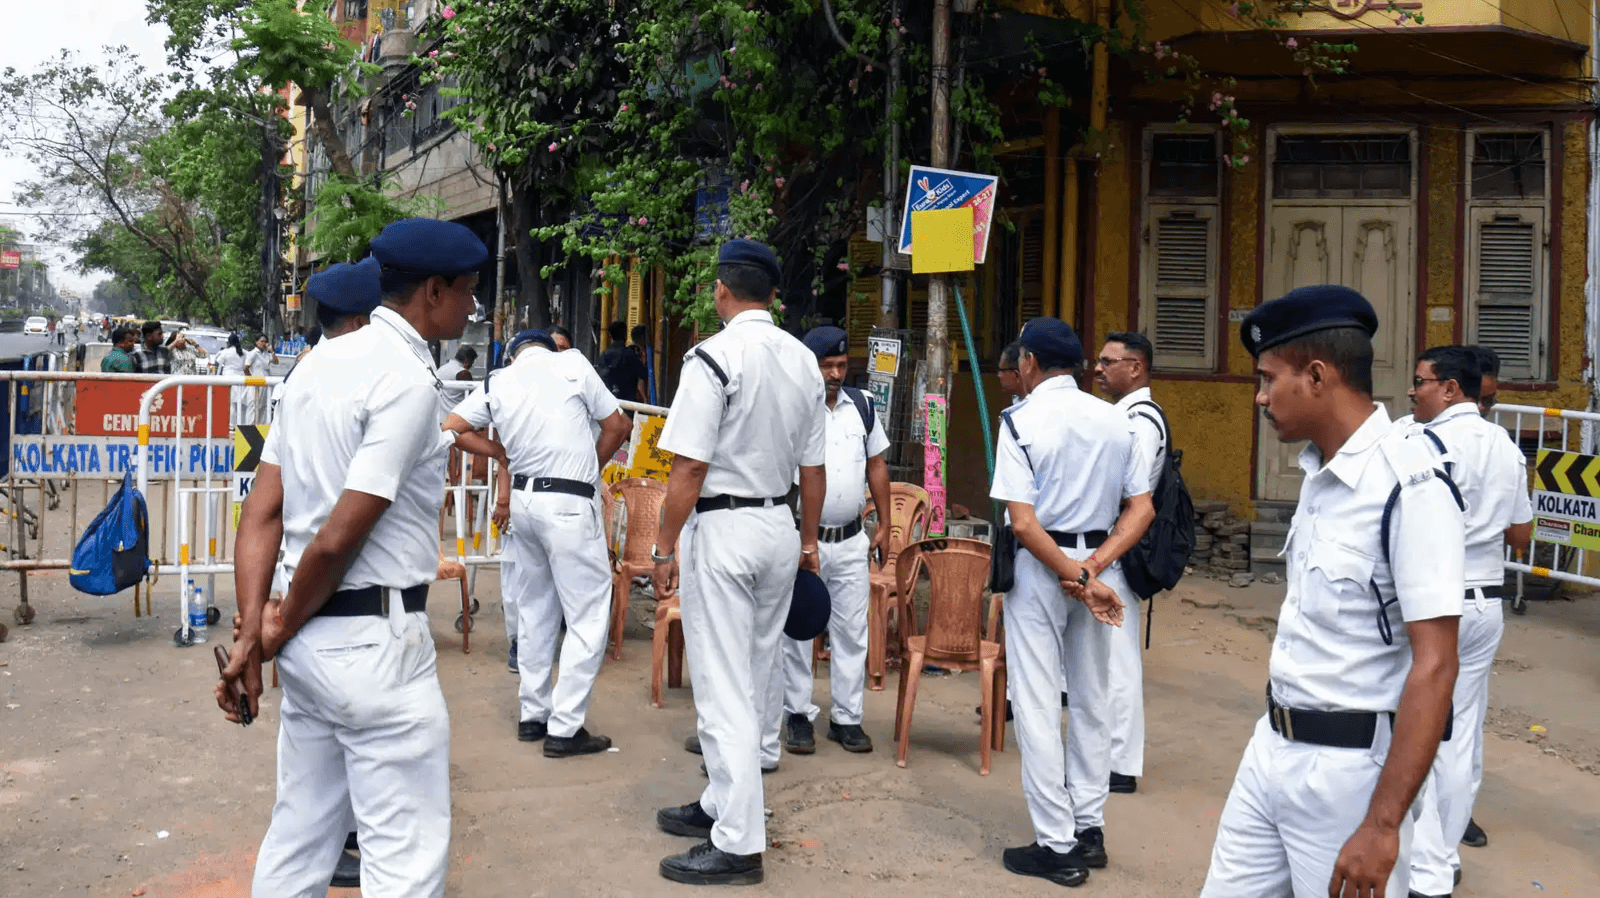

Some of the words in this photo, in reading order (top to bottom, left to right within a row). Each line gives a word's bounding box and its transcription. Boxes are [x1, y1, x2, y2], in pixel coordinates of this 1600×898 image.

[935, 183, 950, 195] Kids
[953, 190, 970, 204] Expert
[103, 413, 197, 433] CENTRYPLY
[14, 444, 100, 472] KOLKATA
[1537, 494, 1596, 519] KOLKATA
[1574, 523, 1600, 537] Char
